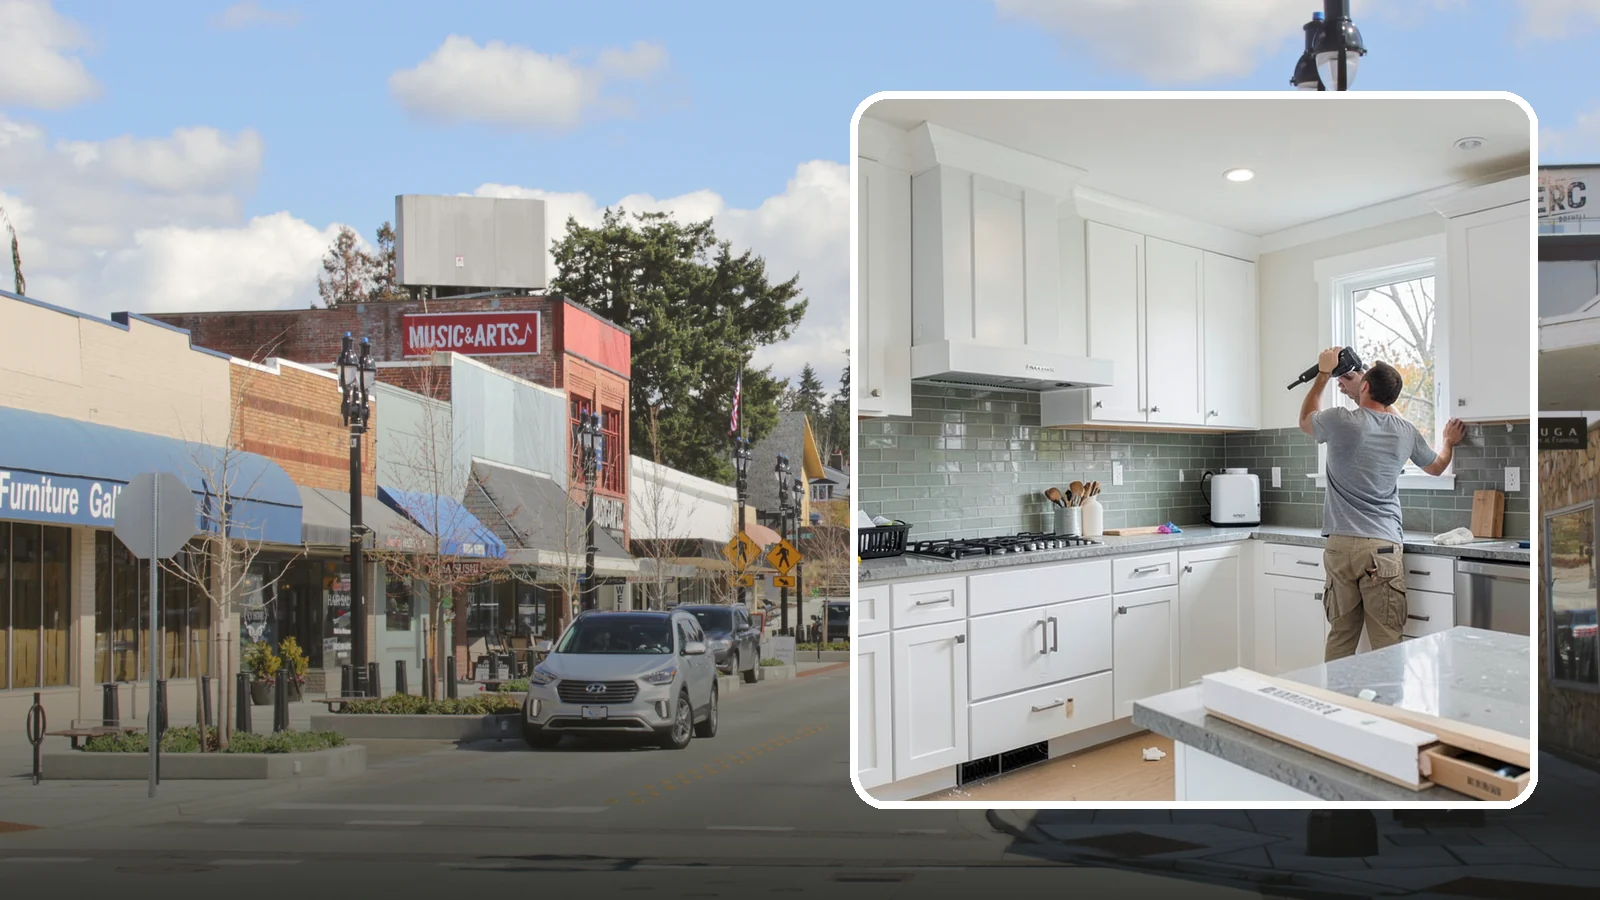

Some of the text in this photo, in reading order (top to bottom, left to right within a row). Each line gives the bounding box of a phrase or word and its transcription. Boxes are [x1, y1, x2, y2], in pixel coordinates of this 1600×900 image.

[1541, 428, 1577, 436] UGA
[0, 471, 79, 516] Furniture
[453, 563, 479, 574] SUSHI
